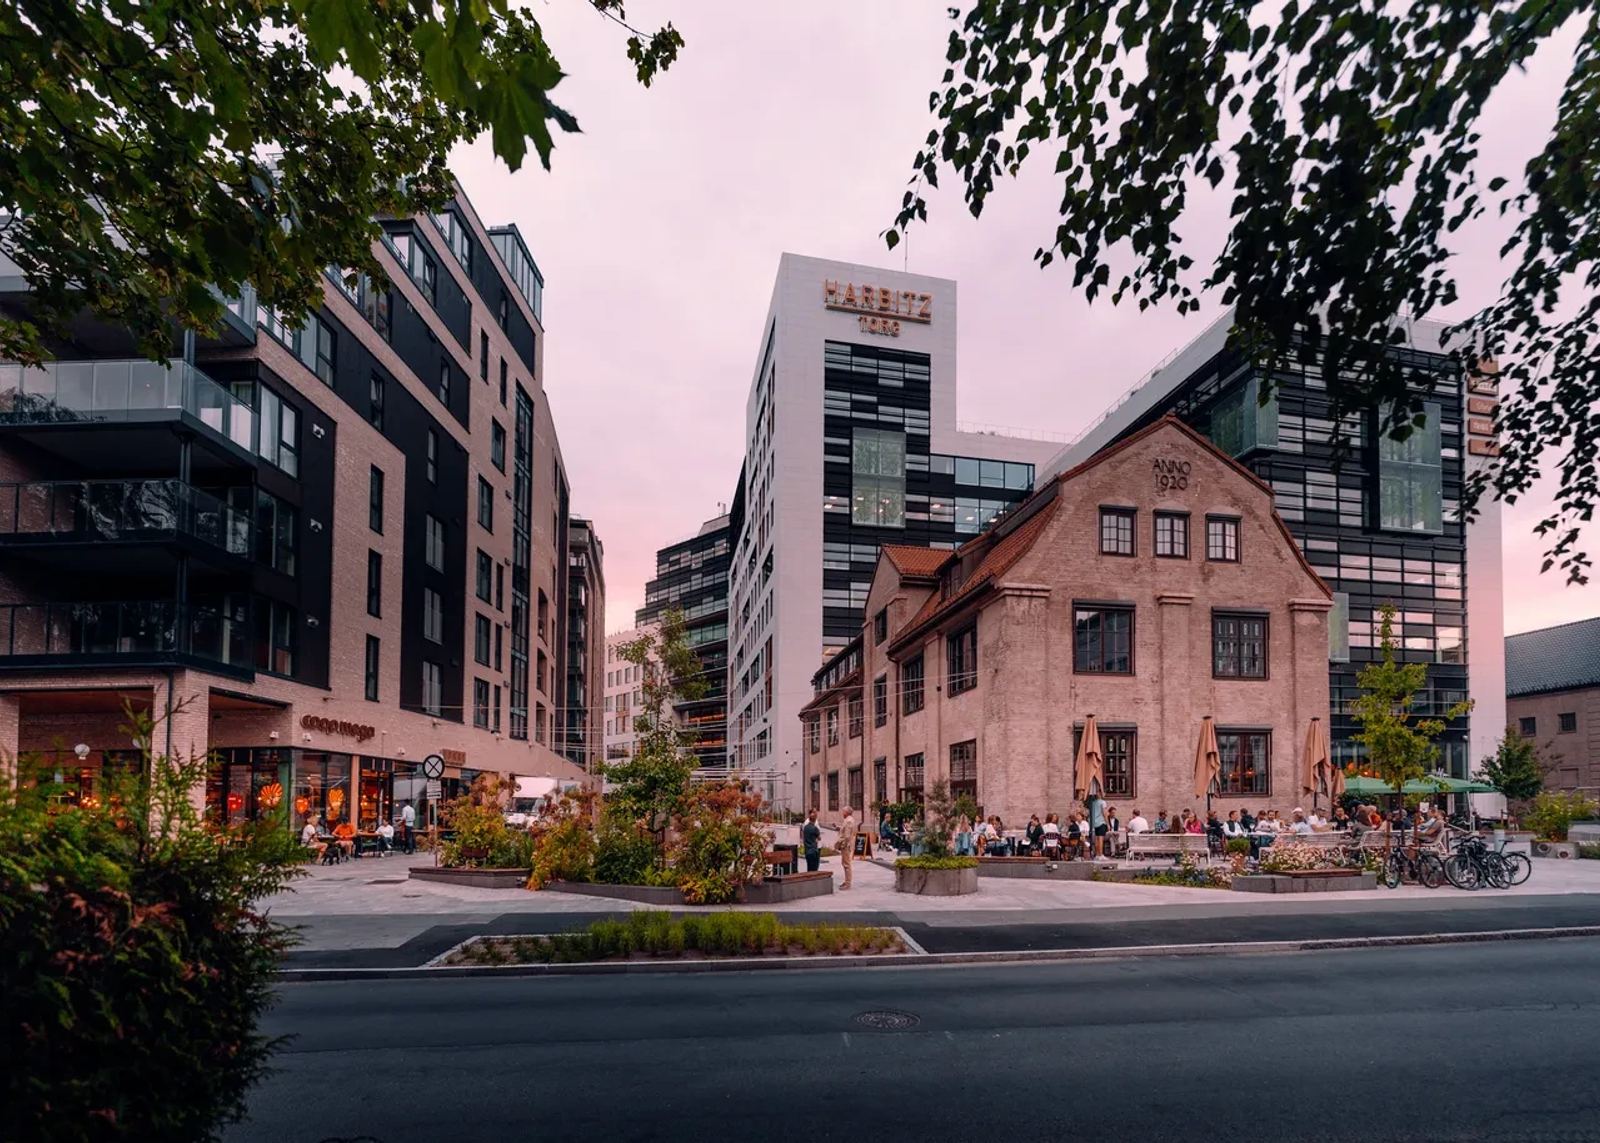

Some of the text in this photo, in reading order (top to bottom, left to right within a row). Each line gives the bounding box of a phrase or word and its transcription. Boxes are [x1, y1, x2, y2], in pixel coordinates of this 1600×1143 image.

[824, 279, 932, 318] HARBITZ
[858, 315, 900, 337] TORG
[1153, 458, 1191, 475] ANNO
[1155, 474, 1188, 491] 1920
